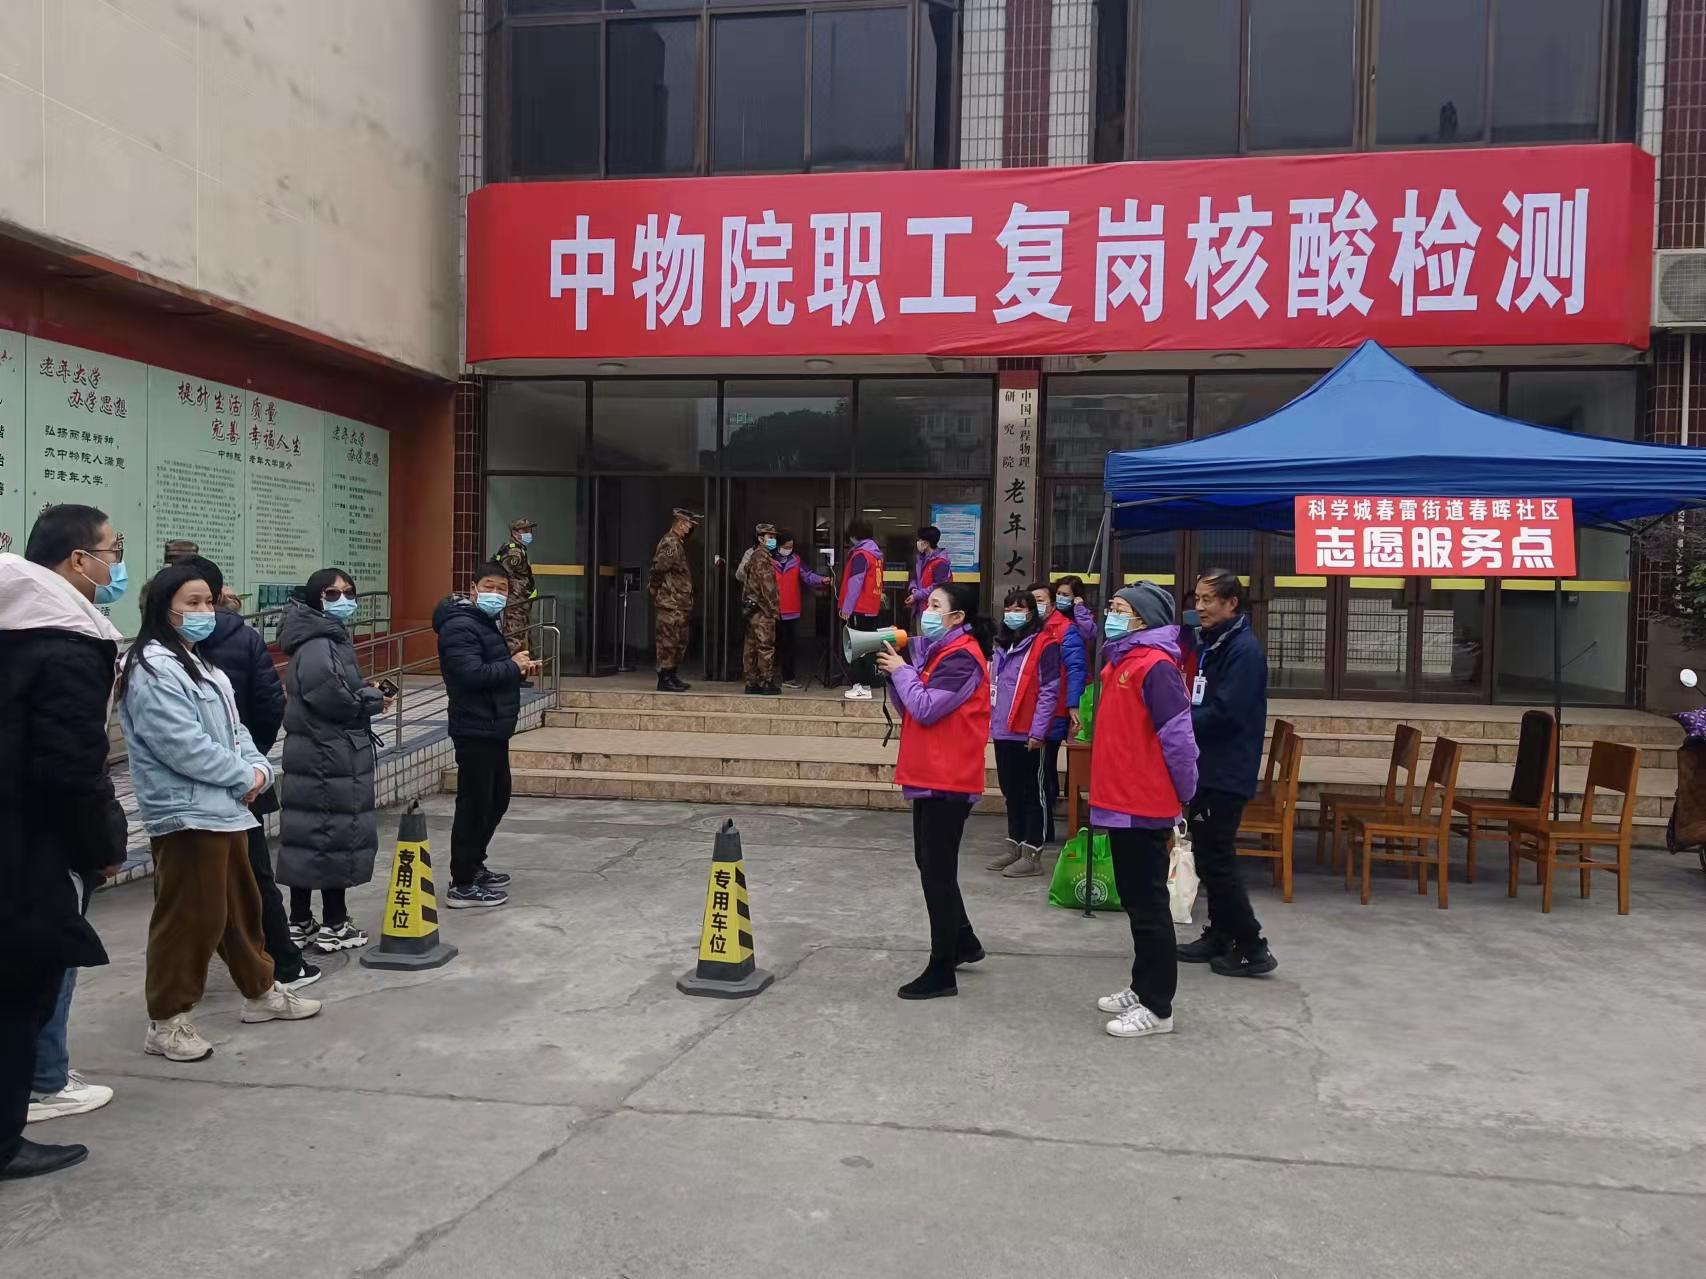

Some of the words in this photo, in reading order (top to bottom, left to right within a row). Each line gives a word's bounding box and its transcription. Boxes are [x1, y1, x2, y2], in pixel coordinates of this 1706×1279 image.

[550, 188, 1589, 331] 中物院职工复岗核酸检测
[1308, 499, 1560, 521] 科学城春雷街道春晖社区
[1315, 526, 1555, 569] 志愿服务点
[392, 848, 415, 929] 专用车位
[709, 869, 731, 954] 专用车位
